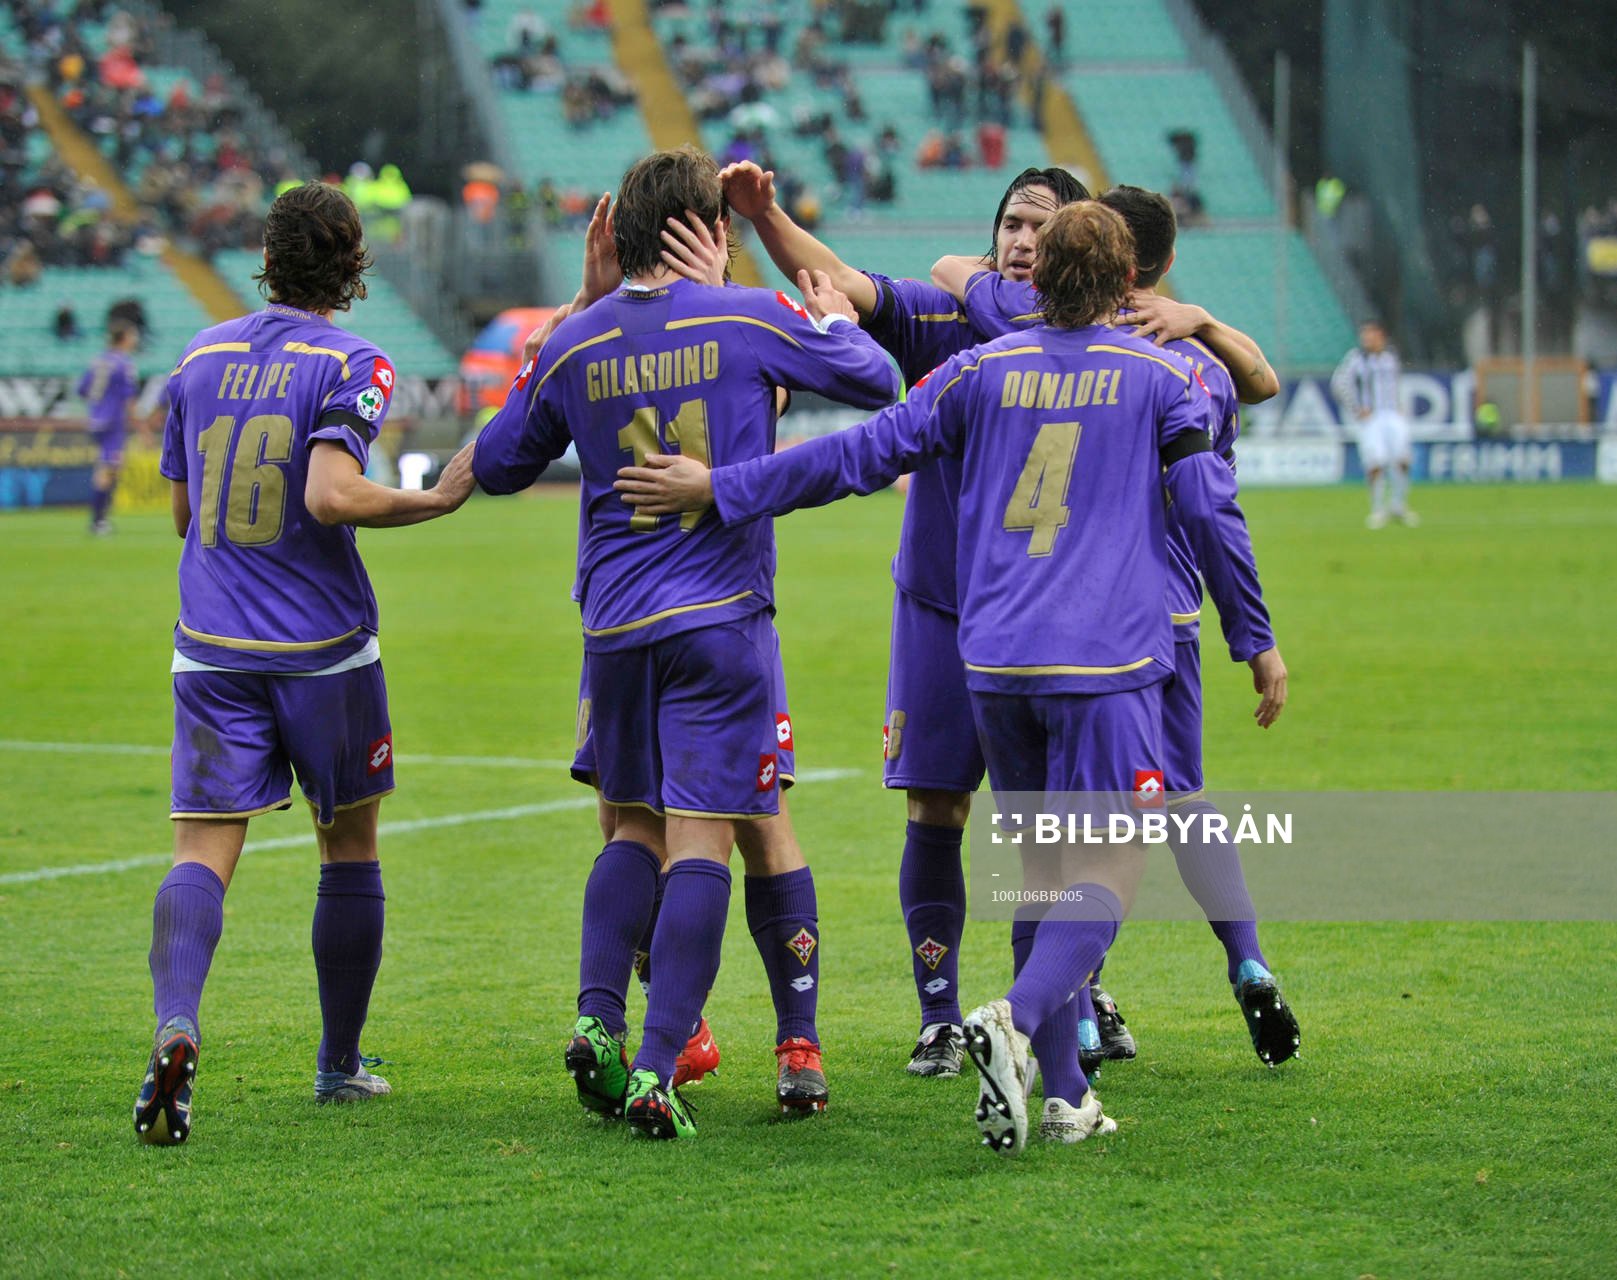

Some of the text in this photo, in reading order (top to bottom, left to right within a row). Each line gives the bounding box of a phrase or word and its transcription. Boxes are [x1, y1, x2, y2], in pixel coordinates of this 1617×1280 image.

[217, 362, 297, 400] FELIPE
[586, 340, 719, 402] GILARDINO
[1000, 369, 1122, 409] DONADEL
[197, 414, 296, 549] 16
[617, 398, 713, 533] 11
[1003, 421, 1082, 559] 4
